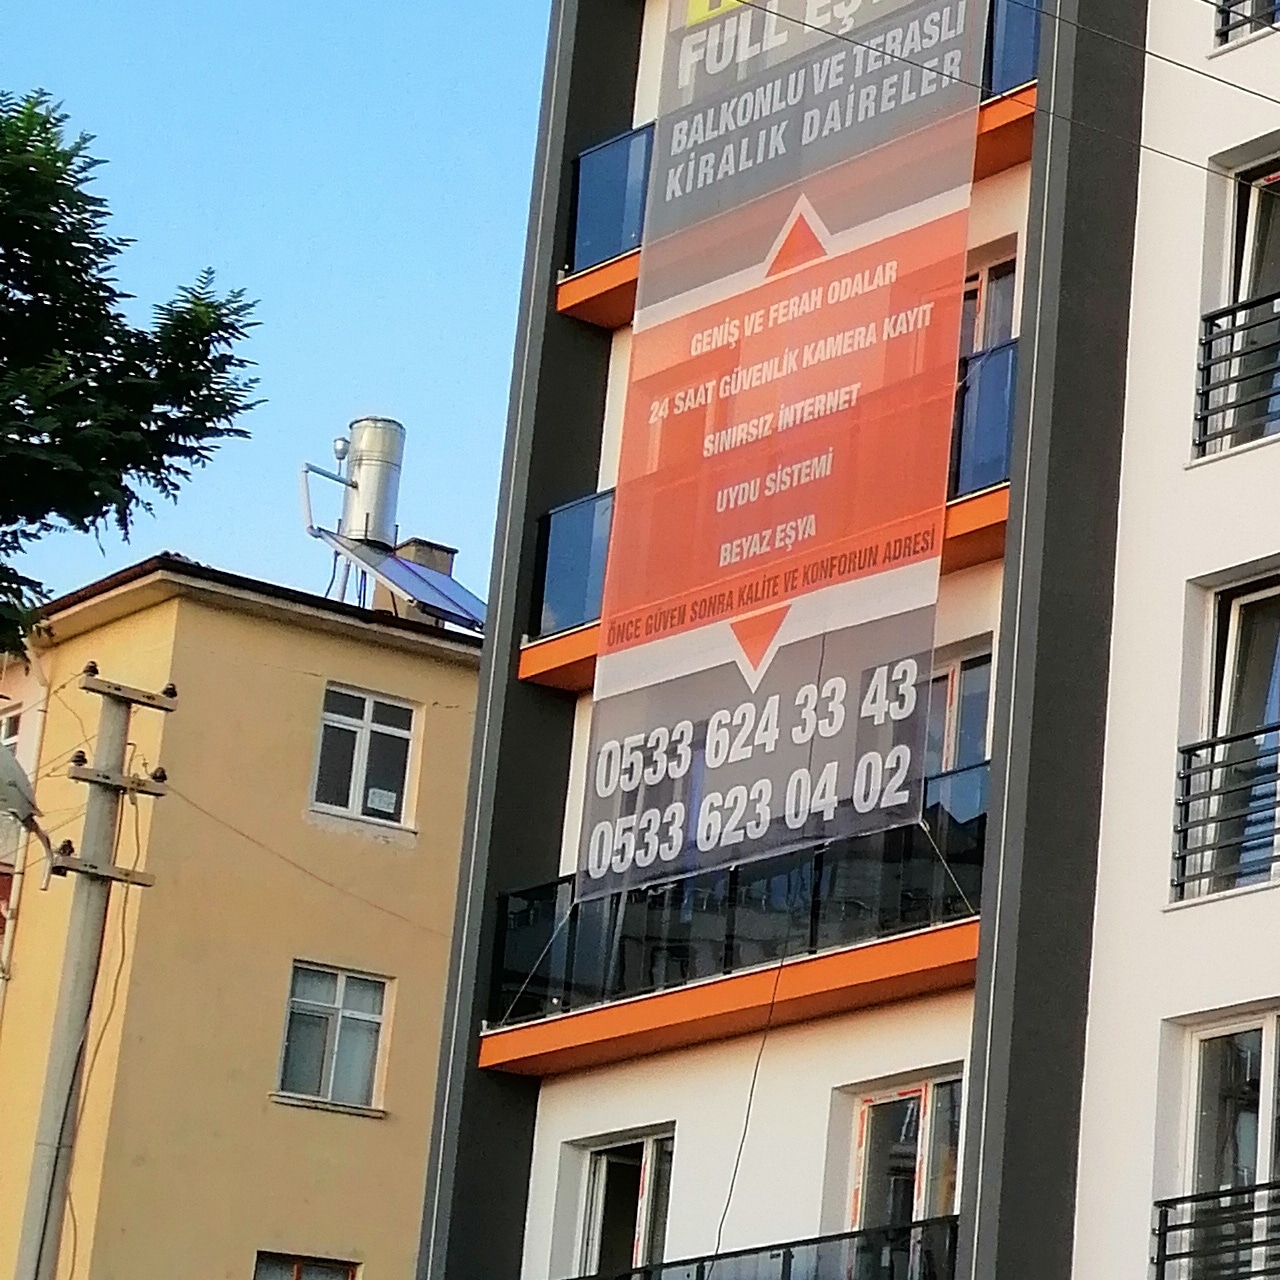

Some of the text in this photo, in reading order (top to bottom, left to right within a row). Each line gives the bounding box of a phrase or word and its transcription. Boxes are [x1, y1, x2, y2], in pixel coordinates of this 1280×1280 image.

[664, 48, 963, 203] KİRALIK DAİRELER
[669, 0, 967, 157] BALKONLU VE TERASLI
[647, 301, 935, 425] 24 SAAT GÜVENLİK KAMERA KAYIT
[689, 259, 898, 351] GENİŞ VE FERAH ODALAR
[702, 381, 862, 459] SINIRSIZ İNTERNET
[715, 446, 834, 514] UYDU SİSTEMİ
[606, 522, 936, 648] ÖNCE GÜVEN SONRA KALİTE VE KONFORUN ADRESİ
[718, 514, 817, 568] BEYAZ EŞYA
[595, 658, 919, 799] 0533 624 33 43
[587, 744, 912, 880] 0533 623 04 02
